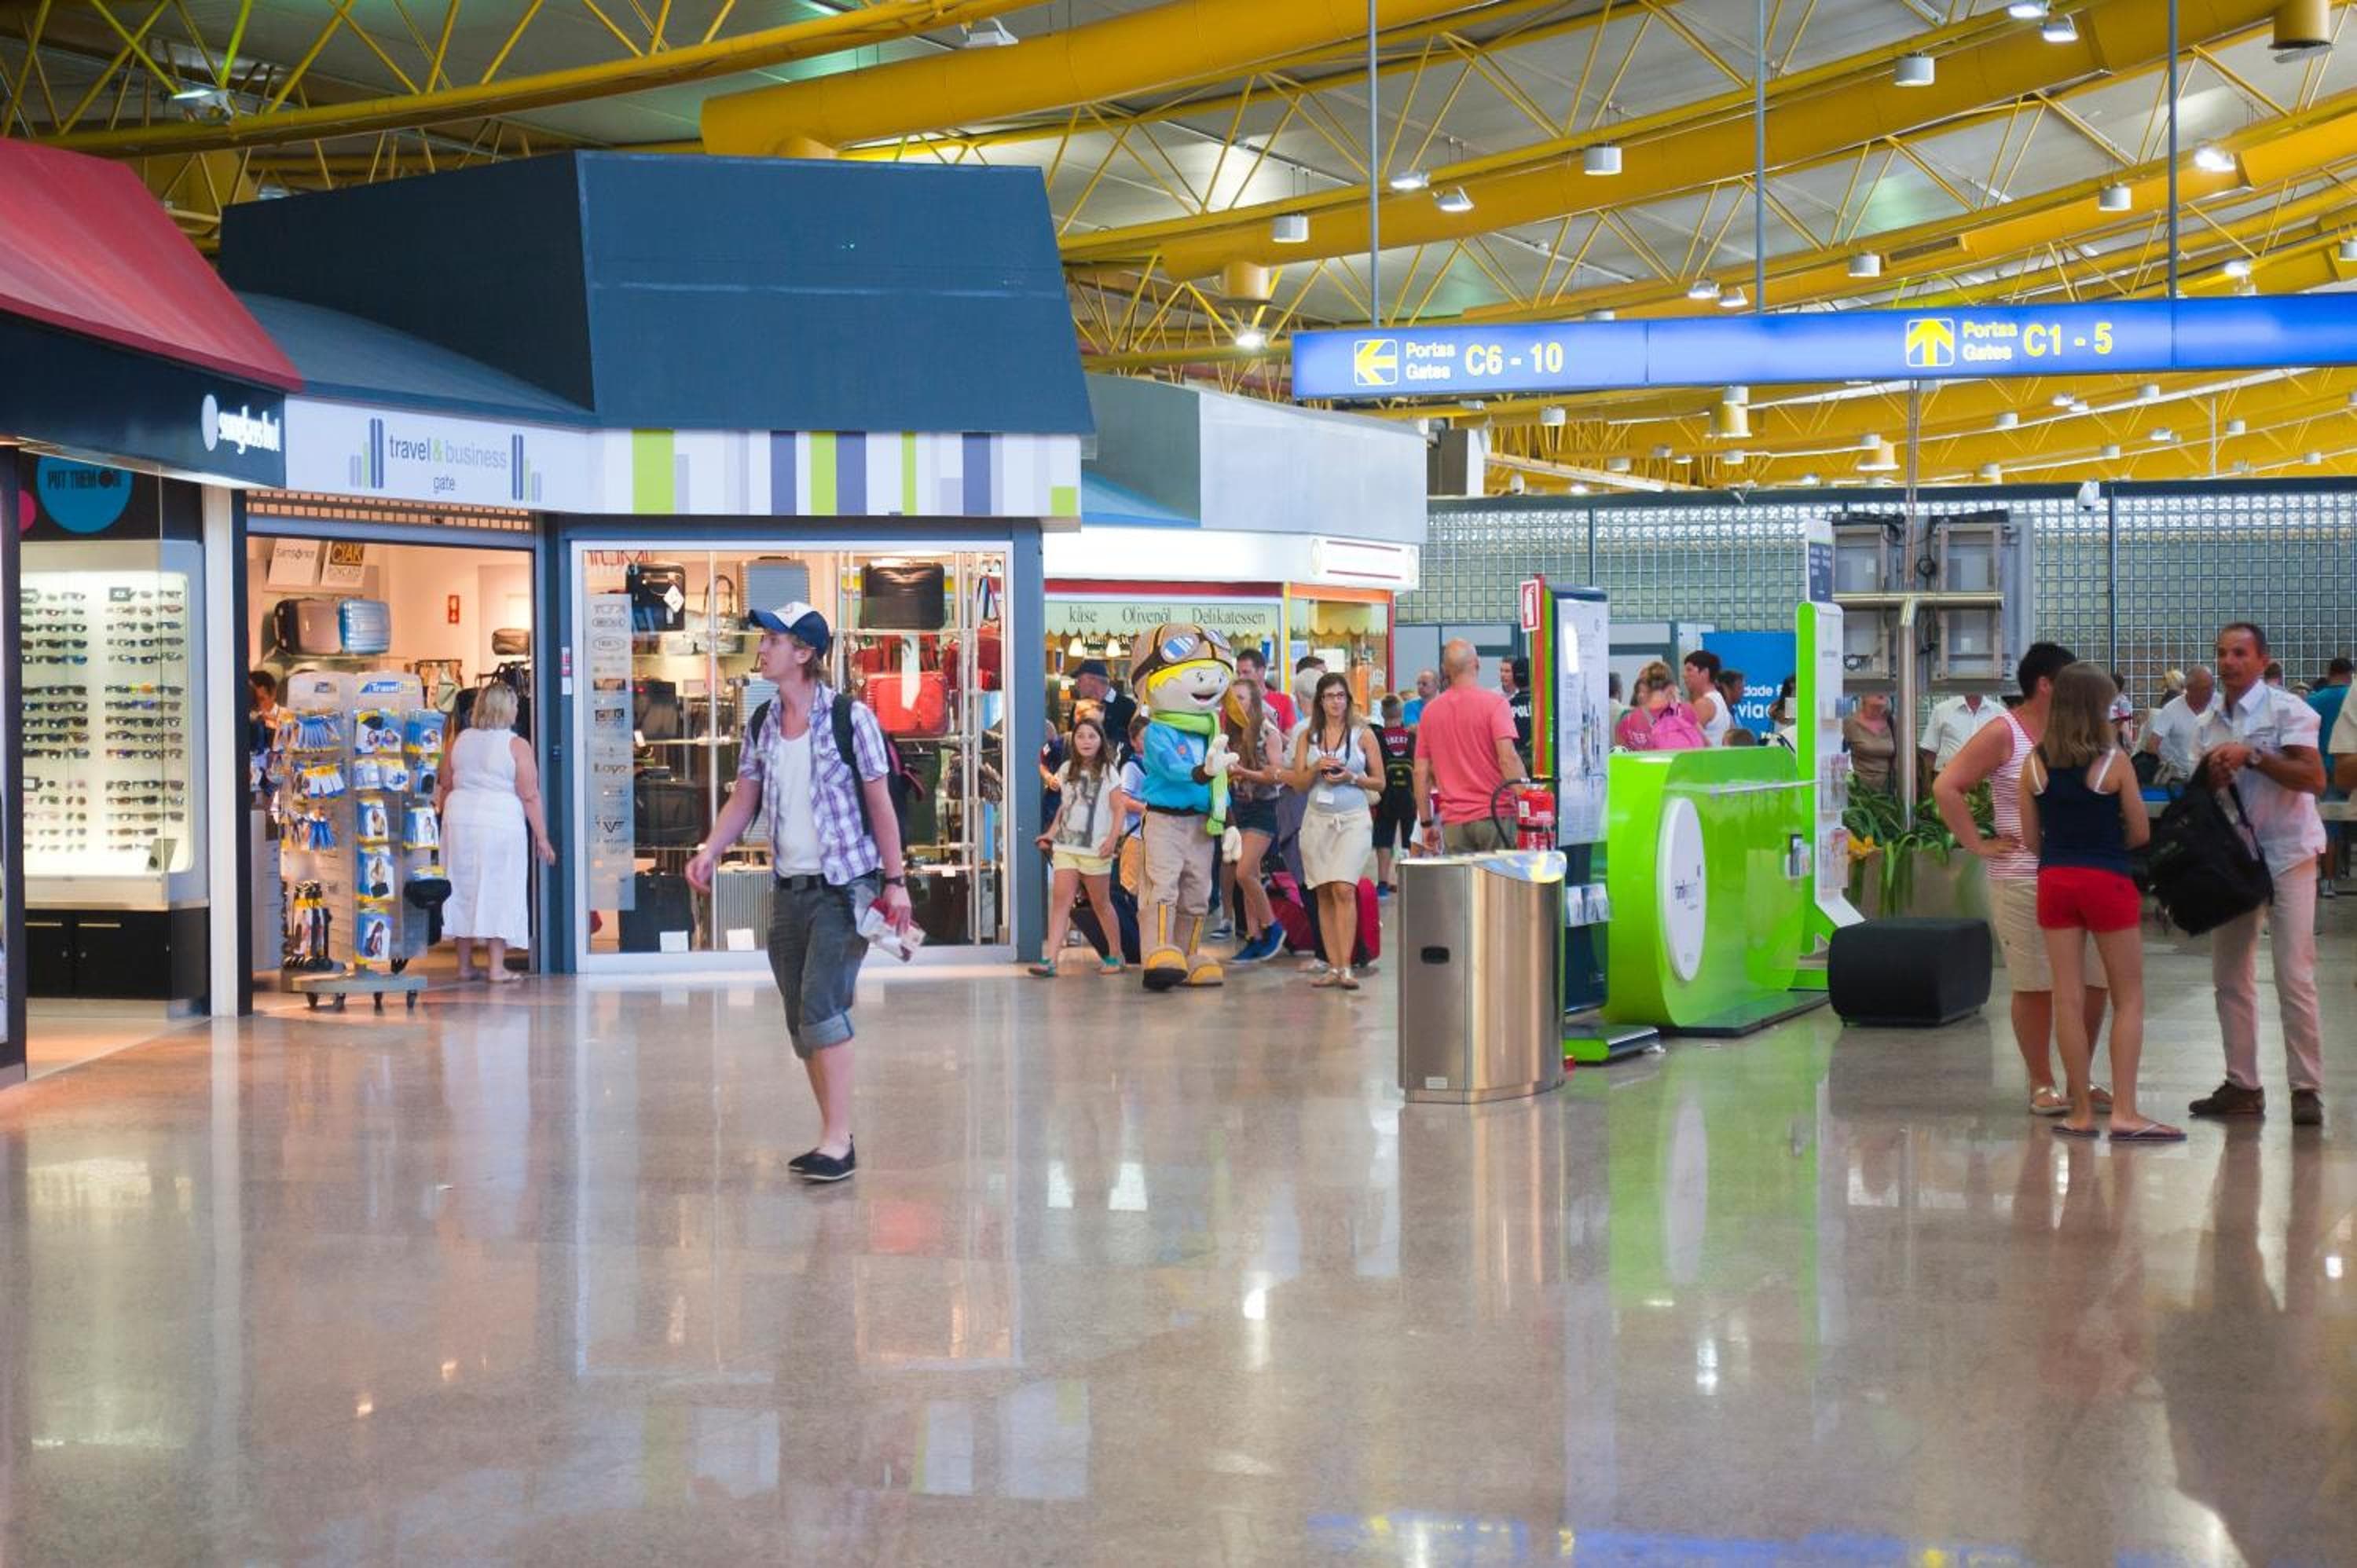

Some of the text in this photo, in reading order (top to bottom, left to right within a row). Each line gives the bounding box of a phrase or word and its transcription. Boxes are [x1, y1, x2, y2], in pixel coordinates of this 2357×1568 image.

[1963, 321, 2018, 338] Portas
[2025, 324, 2061, 357] C1
[2095, 322, 2113, 354] 5
[1406, 342, 1455, 358] Portas
[1465, 344, 1503, 376] C6
[1530, 342, 1563, 373] 10
[1963, 343, 2012, 361] Gates
[1406, 364, 1451, 379] Gates
[433, 474, 456, 494] gate
[1193, 607, 1266, 625] Delikatessen
